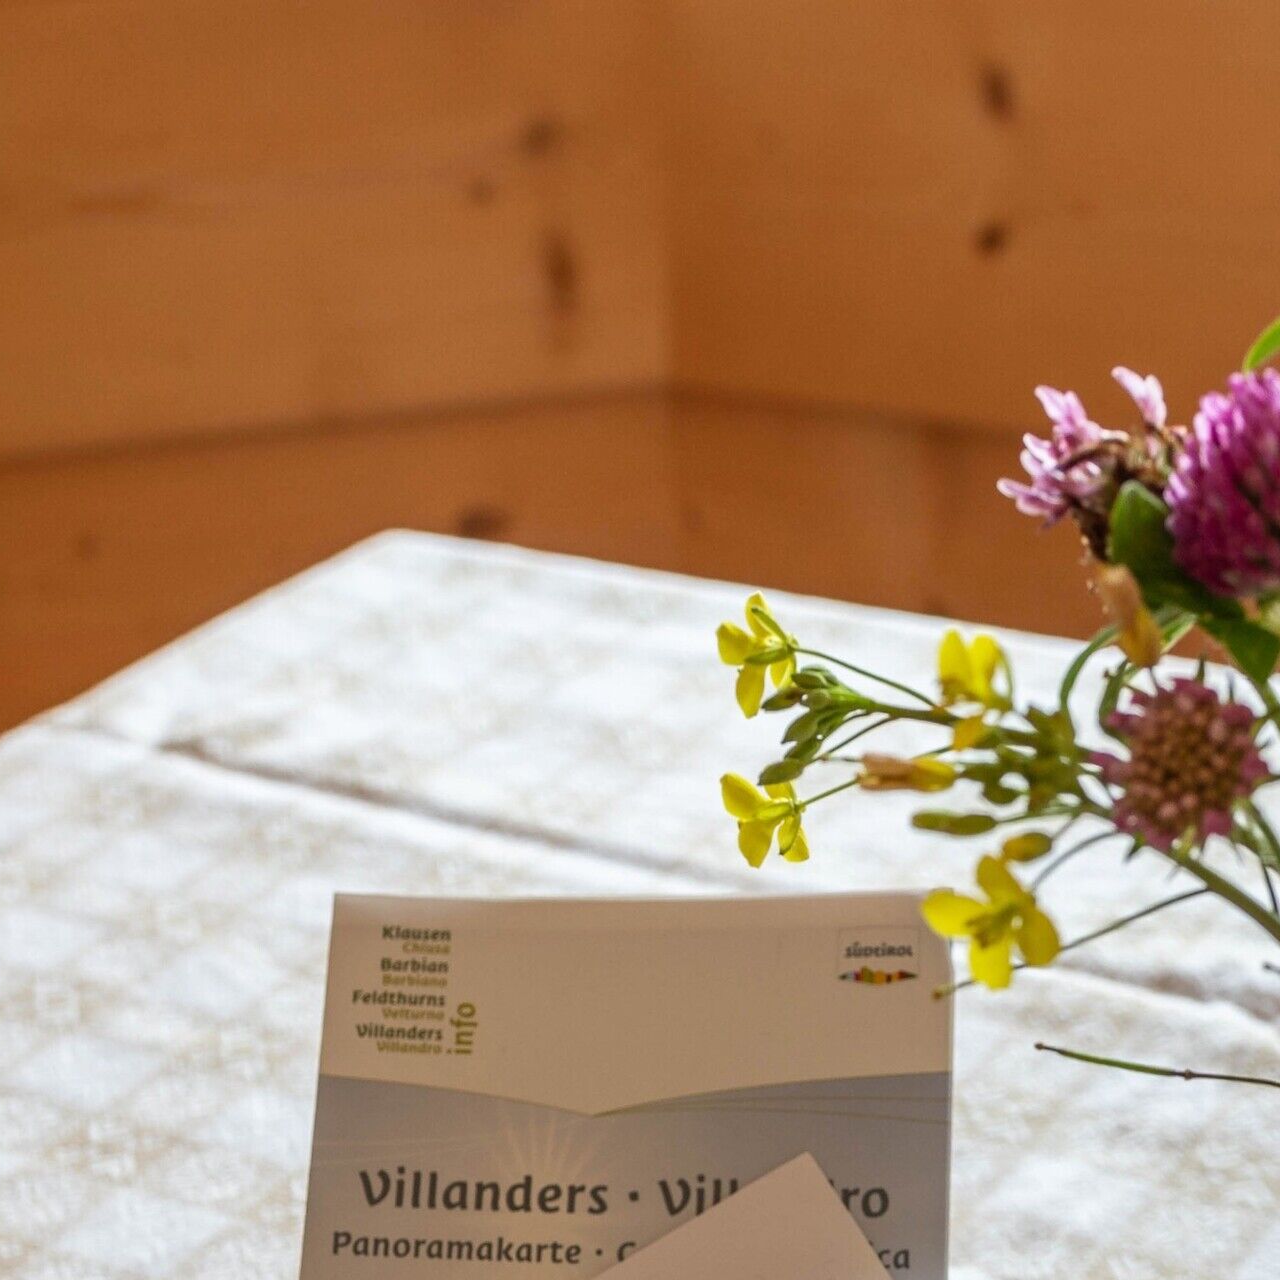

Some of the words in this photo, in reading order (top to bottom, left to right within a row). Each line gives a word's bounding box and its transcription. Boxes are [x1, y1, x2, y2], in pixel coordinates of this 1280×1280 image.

[382, 925, 451, 941] Klausen
[381, 957, 449, 973] Barbian
[352, 989, 446, 1006] Feldthurns
[356, 1023, 442, 1040] Villanders
[359, 1165, 609, 1216] Villanders
[332, 1230, 581, 1264] Panoramakarte
